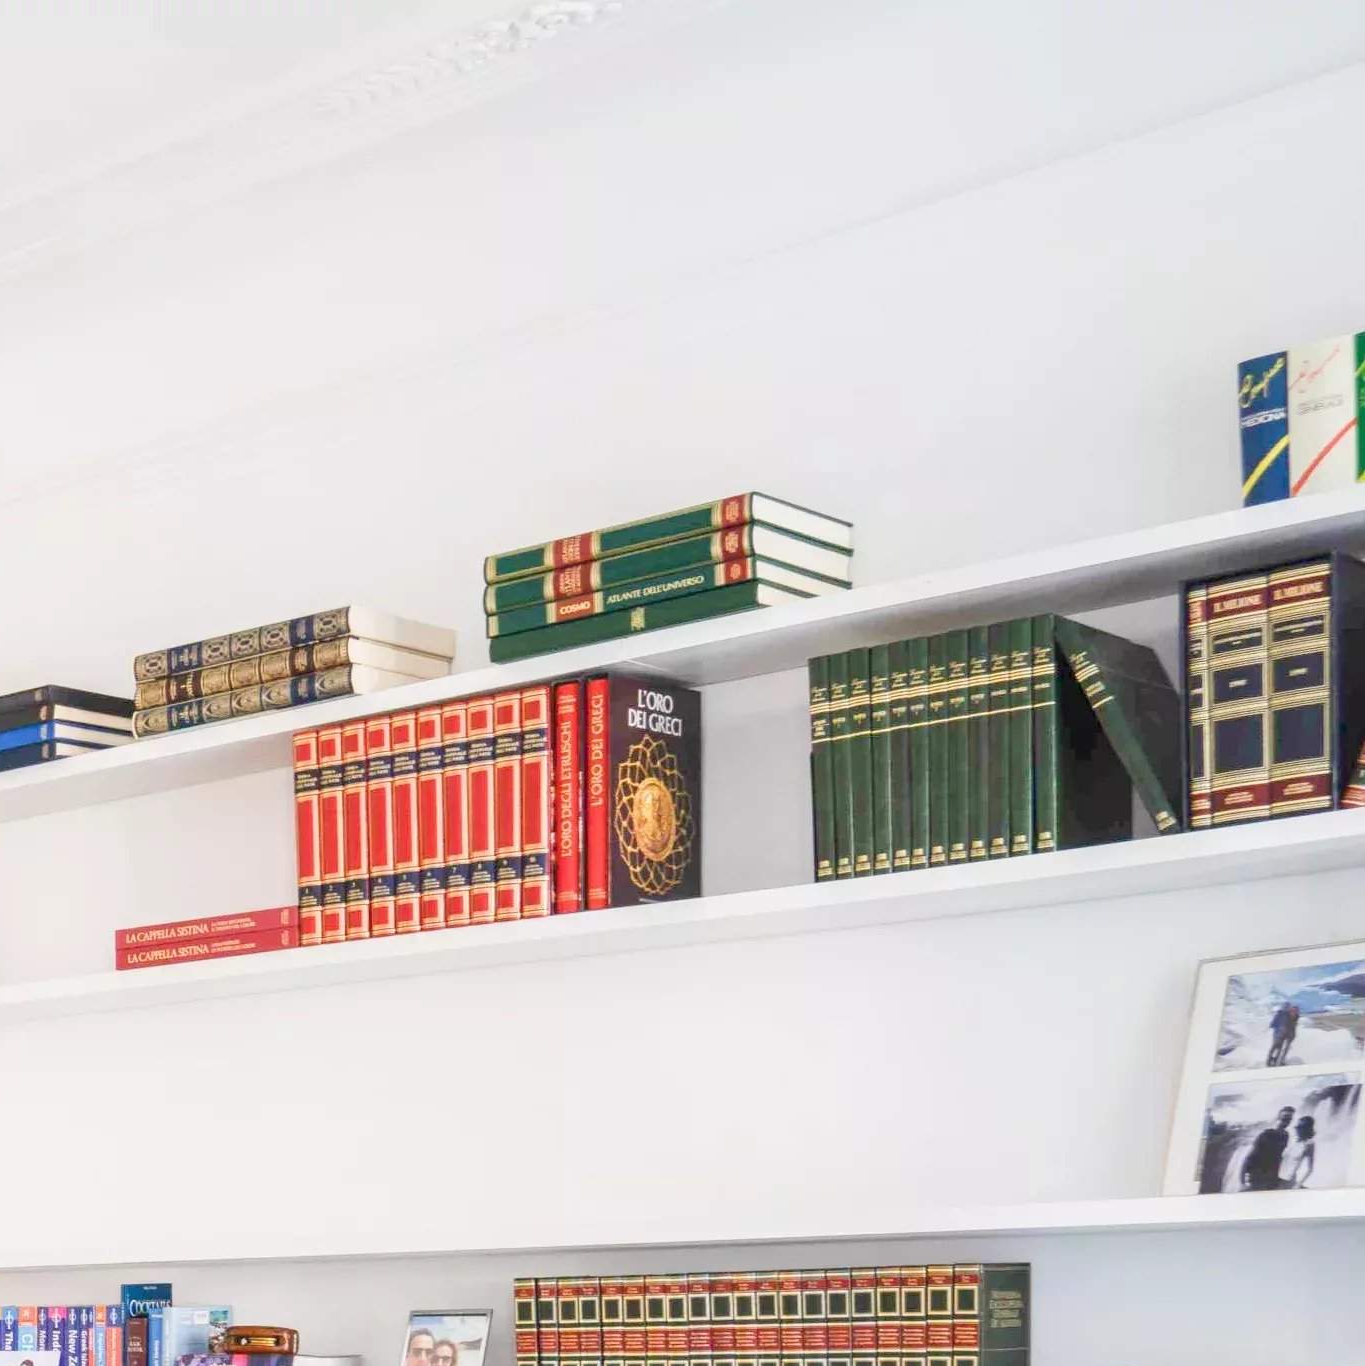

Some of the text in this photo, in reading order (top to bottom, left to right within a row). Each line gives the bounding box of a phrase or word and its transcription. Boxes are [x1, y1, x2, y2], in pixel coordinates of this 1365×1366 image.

[606, 575, 705, 604] ATLANTE DELL'UNIVERSO
[559, 600, 591, 615] COSMO
[637, 689, 674, 713] L'ORO
[628, 708, 683, 736] DEI GRECI
[590, 694, 604, 806] L'ORO DEI GRECI
[561, 720, 572, 858] L'ORO DEGLI ETRUSCHI
[126, 933, 137, 944] LA
[137, 928, 176, 942] CAPPELLA
[177, 923, 209, 937] SISTINA
[127, 953, 138, 964] LA
[138, 948, 177, 961] CAPPELLA
[178, 944, 209, 957] SISTINA
[5, 1332, 14, 1351] Tha
[68, 1330, 78, 1353] New
